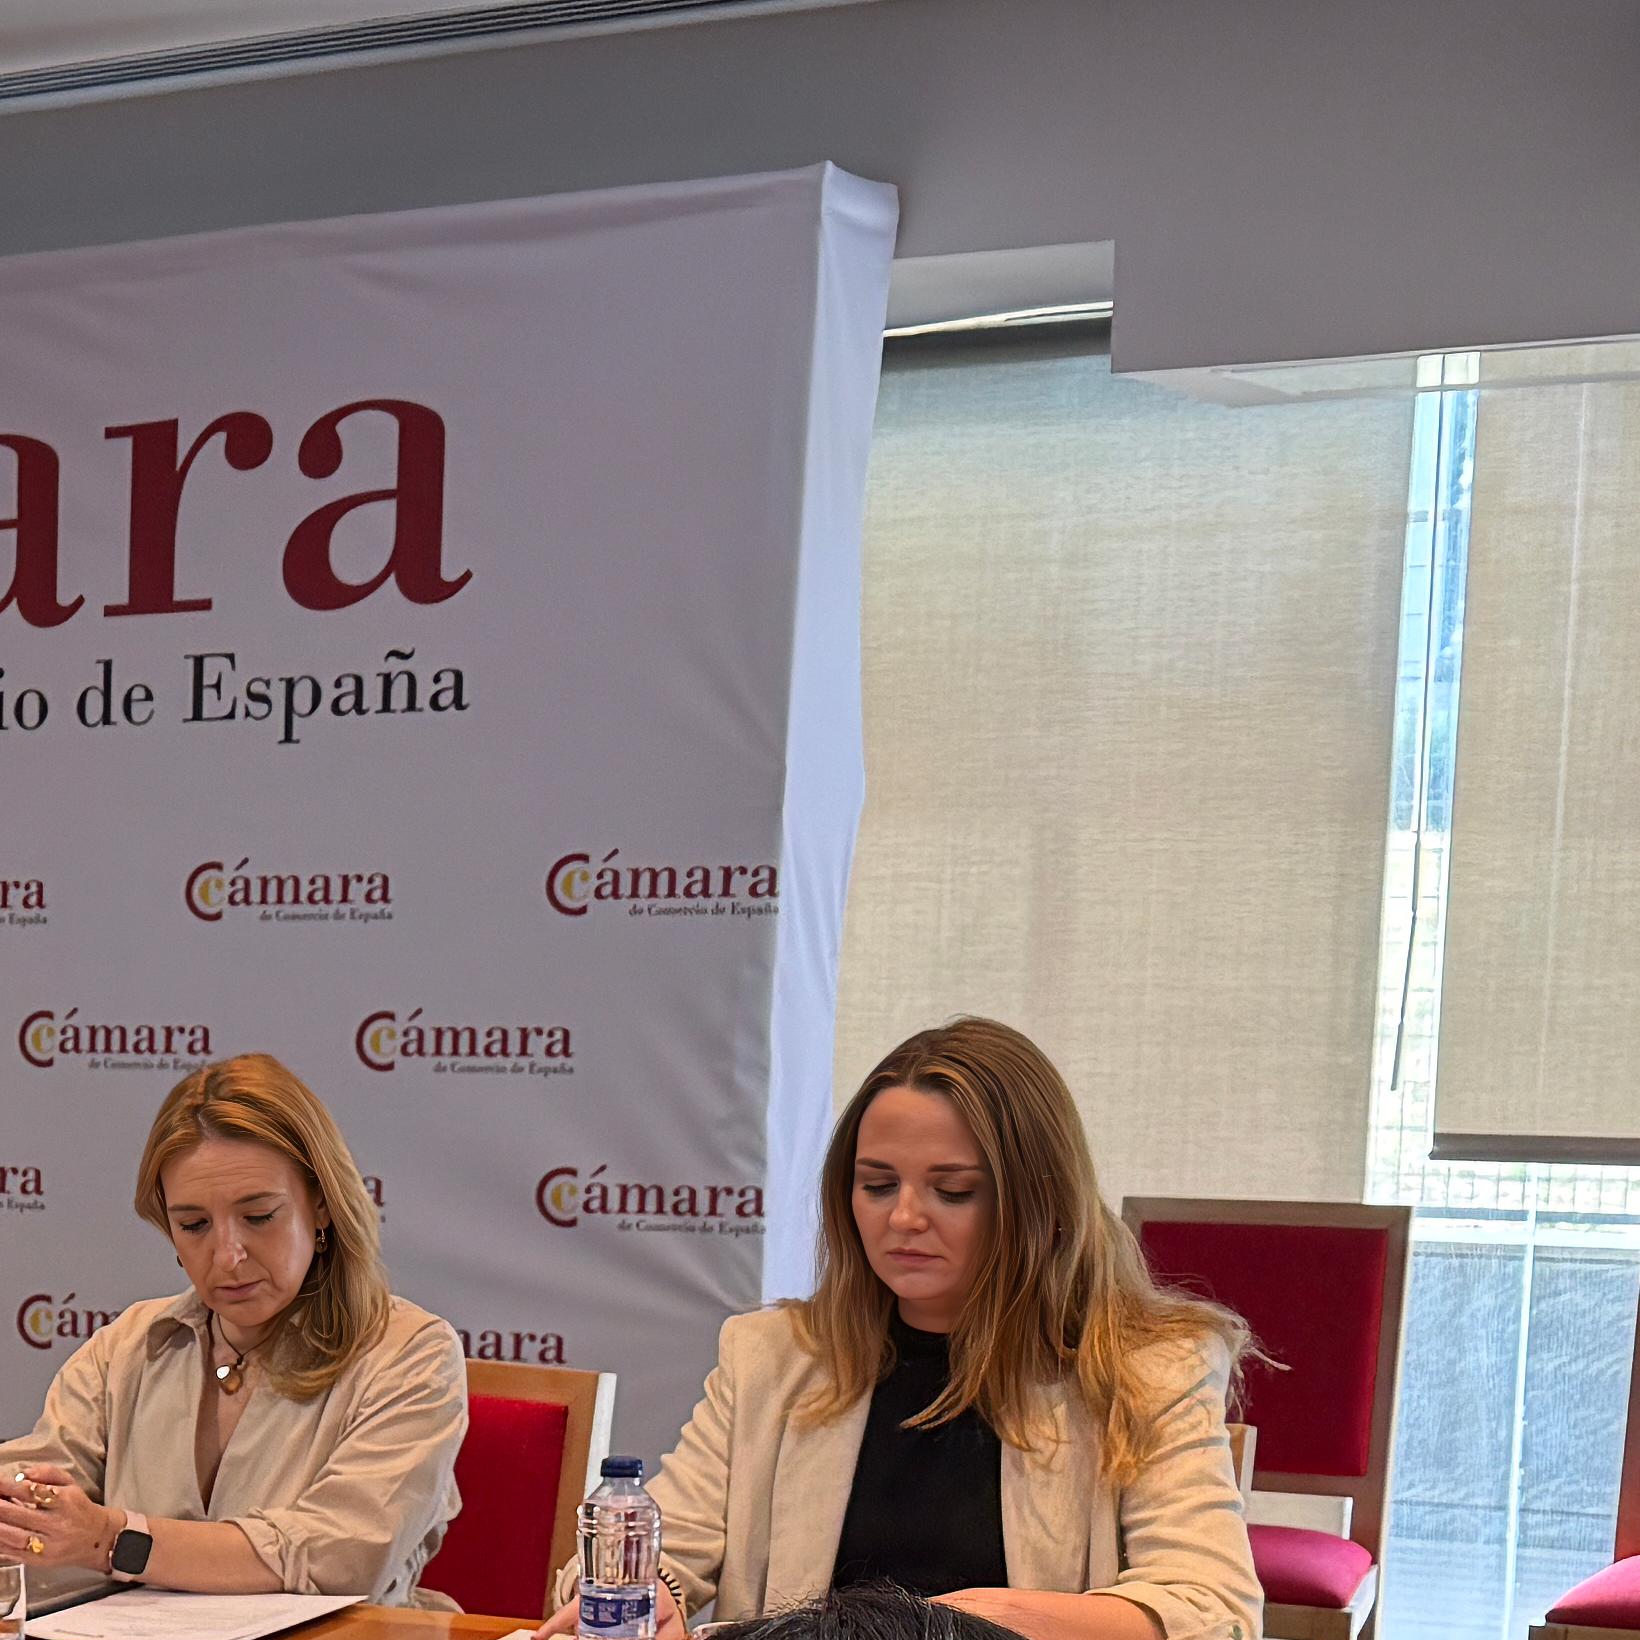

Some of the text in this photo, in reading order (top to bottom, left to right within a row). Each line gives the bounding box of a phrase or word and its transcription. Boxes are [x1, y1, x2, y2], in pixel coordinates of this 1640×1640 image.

[76, 659, 154, 727] de
[182, 648, 470, 744] España
[185, 857, 392, 921] Cámara
[545, 848, 779, 917] Cámara
[19, 1007, 212, 1068] Cámara
[356, 1008, 574, 1072] Cámara
[536, 1164, 765, 1228] Cámara
